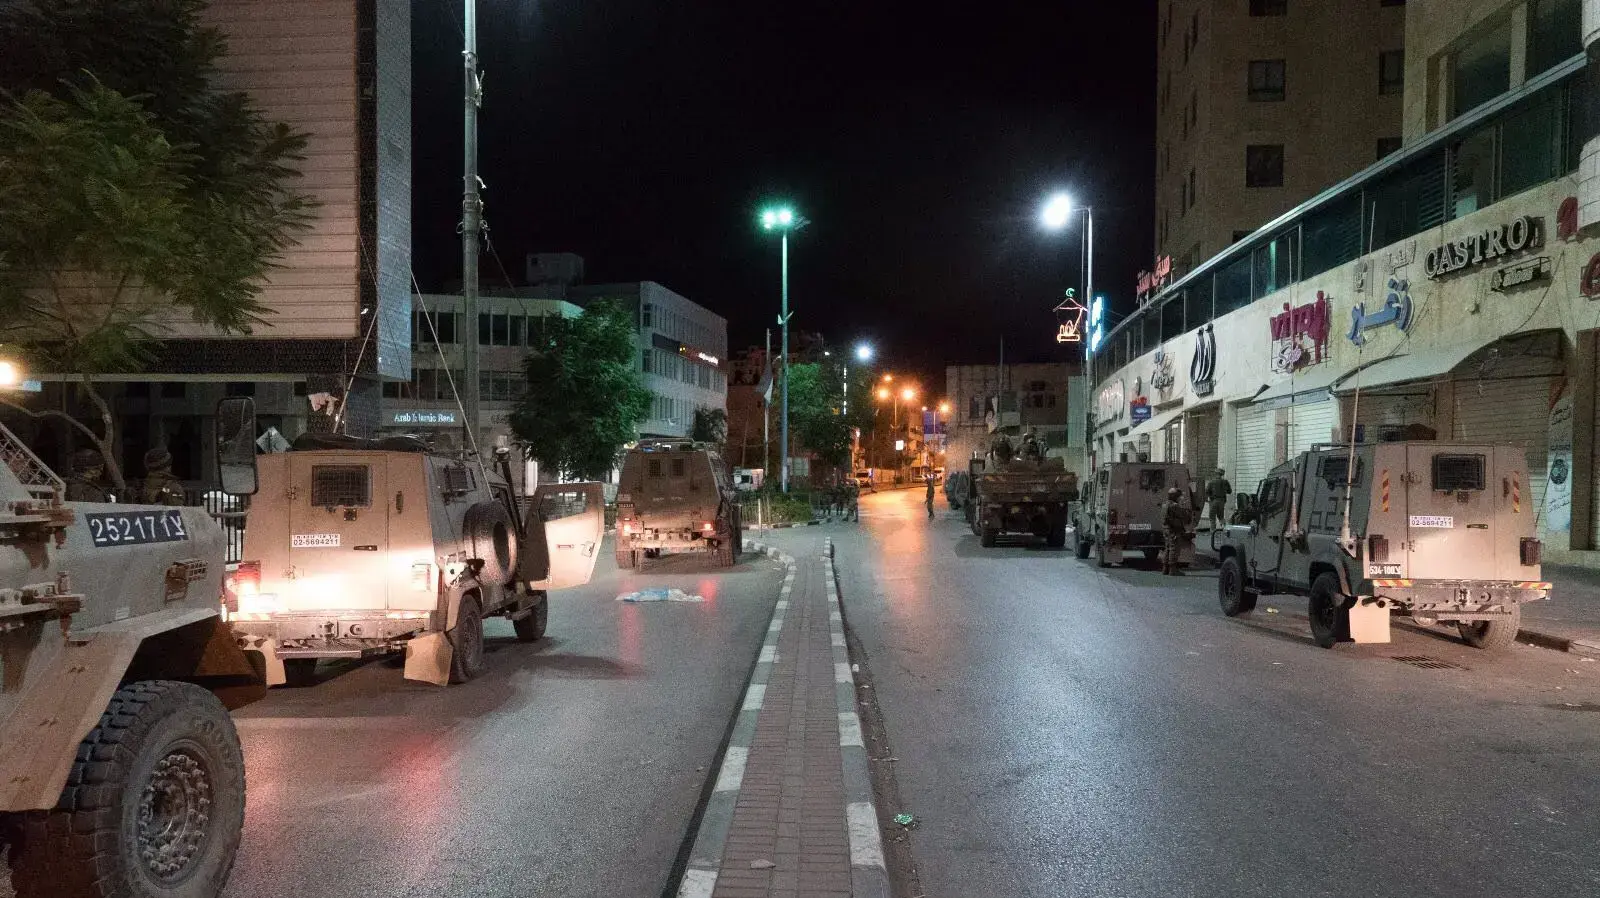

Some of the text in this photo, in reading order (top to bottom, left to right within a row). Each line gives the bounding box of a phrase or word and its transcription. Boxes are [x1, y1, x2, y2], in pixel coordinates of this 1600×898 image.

[1424, 215, 1529, 279] CASTRO
[394, 412, 411, 423] Arab
[437, 413, 456, 423] Bank
